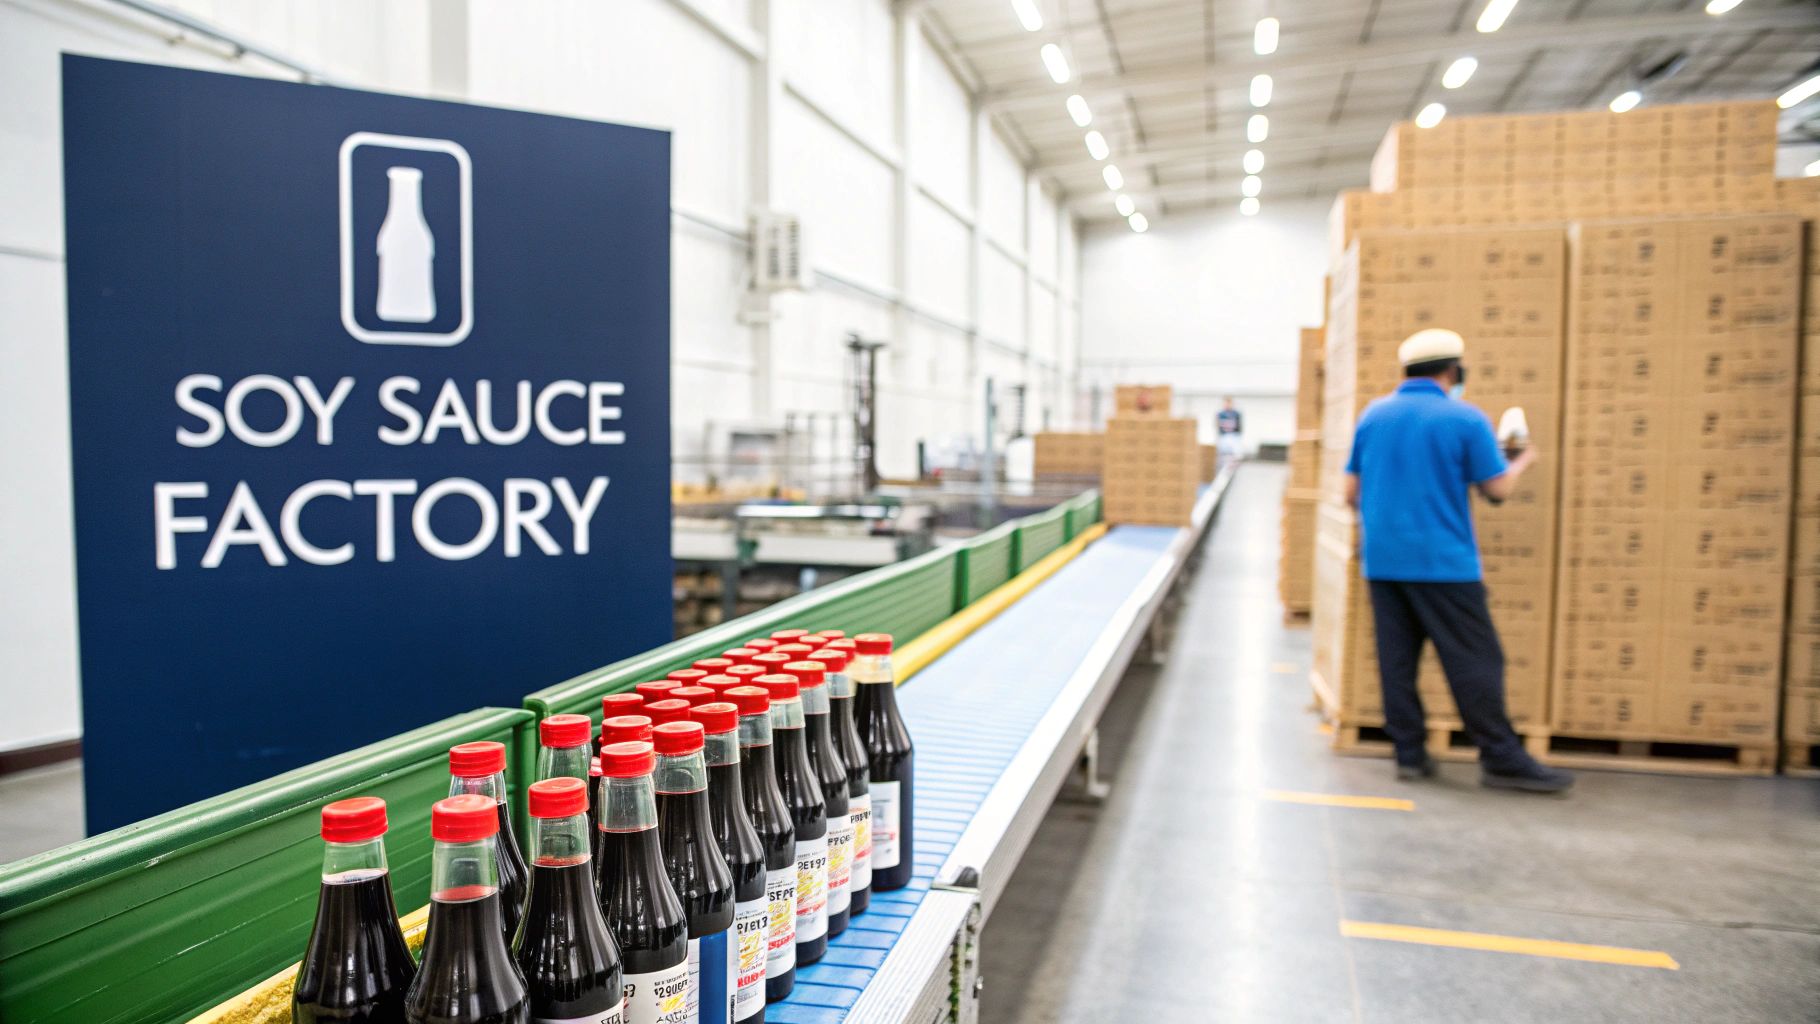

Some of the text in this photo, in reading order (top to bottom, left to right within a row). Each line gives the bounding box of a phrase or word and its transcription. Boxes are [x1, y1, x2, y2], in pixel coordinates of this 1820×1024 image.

[176, 375, 625, 447] SOY SAUCE
[155, 477, 608, 569] FACTORY
